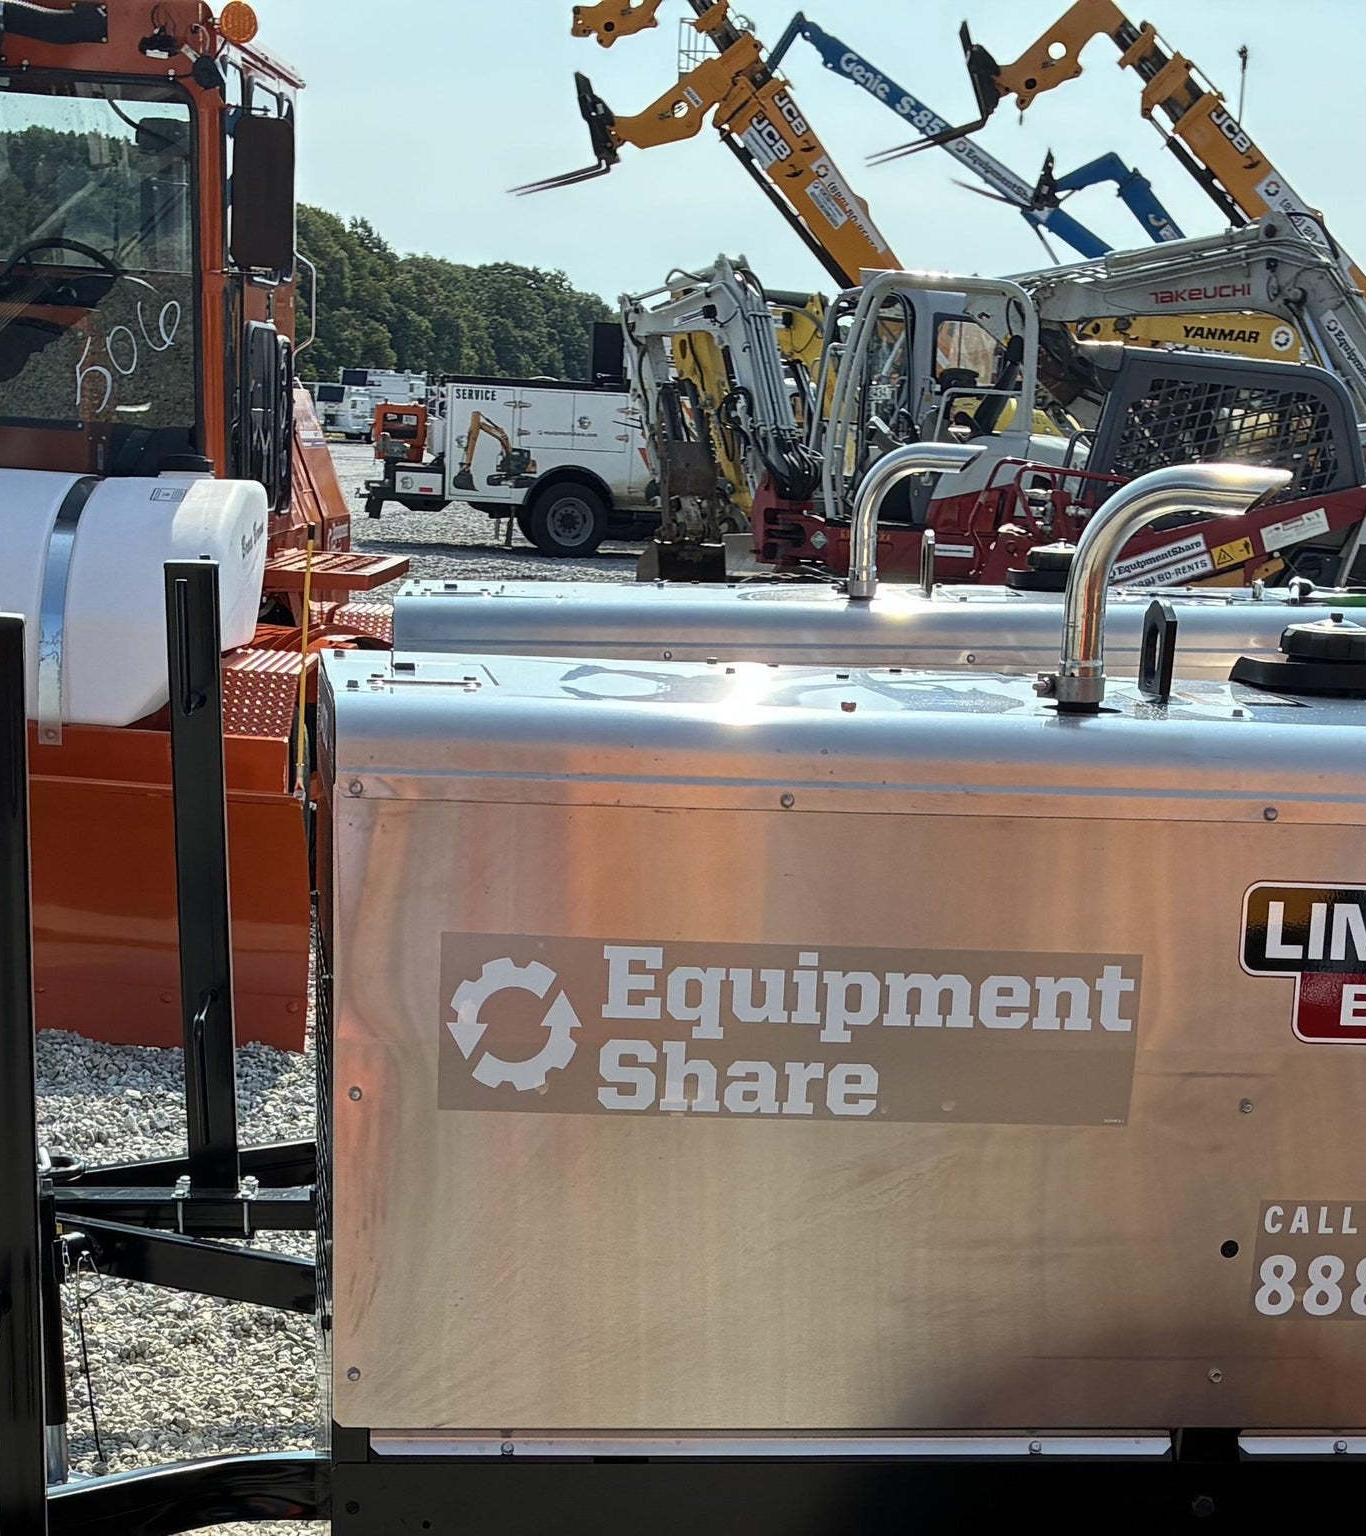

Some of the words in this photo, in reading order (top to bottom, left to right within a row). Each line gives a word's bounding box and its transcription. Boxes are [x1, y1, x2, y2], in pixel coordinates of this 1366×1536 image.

[774, 94, 808, 136] JCB
[896, 96, 946, 137] S-85
[1211, 110, 1252, 153] JCB
[751, 117, 792, 160] JCB
[1183, 325, 1260, 344] YANMAR
[455, 388, 497, 401] SERVICE
[1117, 541, 1202, 575] EquipmentShare
[600, 945, 1135, 1043] Equipment
[597, 1038, 880, 1116] Share
[1264, 1206, 1358, 1235] CALL
